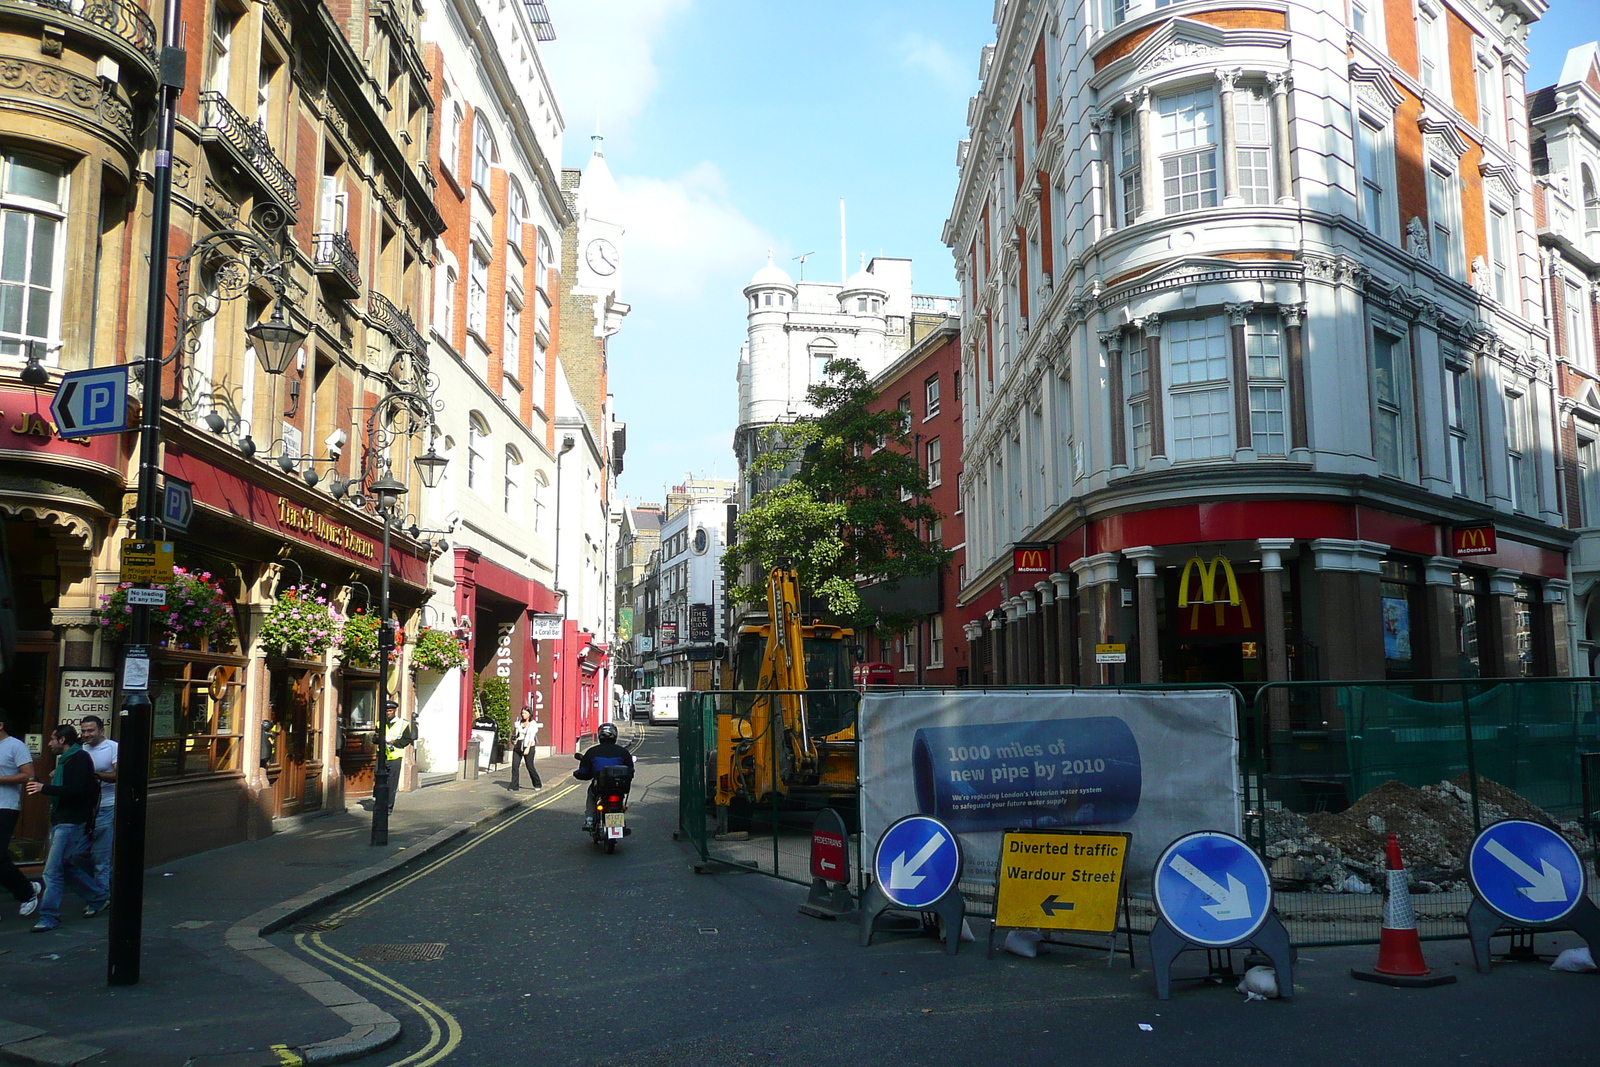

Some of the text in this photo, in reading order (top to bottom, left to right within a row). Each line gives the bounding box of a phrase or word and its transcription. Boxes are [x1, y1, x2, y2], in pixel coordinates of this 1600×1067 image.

[90, 387, 110, 421] P
[170, 491, 180, 514] P
[314, 513, 344, 547] JAMES
[343, 525, 374, 559] TAVERN
[1457, 546, 1492, 554] McDonald's
[141, 590, 164, 598] loading
[535, 619, 548, 628] Sugar
[776, 589, 784, 645] MURPHY
[496, 622, 515, 681] Resta
[64, 678, 80, 688] ST.
[68, 689, 112, 698] TAVERN
[67, 703, 110, 712] LAGERS
[947, 738, 1067, 763] 1000 miles of
[950, 757, 1106, 784] new pipe by 2010
[951, 786, 1102, 802] We're replacing London's Victorian water system
[960, 801, 991, 811] safeguard
[991, 801, 1006, 810] your
[1006, 799, 1027, 808] future
[1046, 797, 1068, 807] supply
[611, 826, 620, 835] L
[1009, 840, 1119, 858] Diverted traffic
[1006, 866, 1116, 883] Wardour Street
